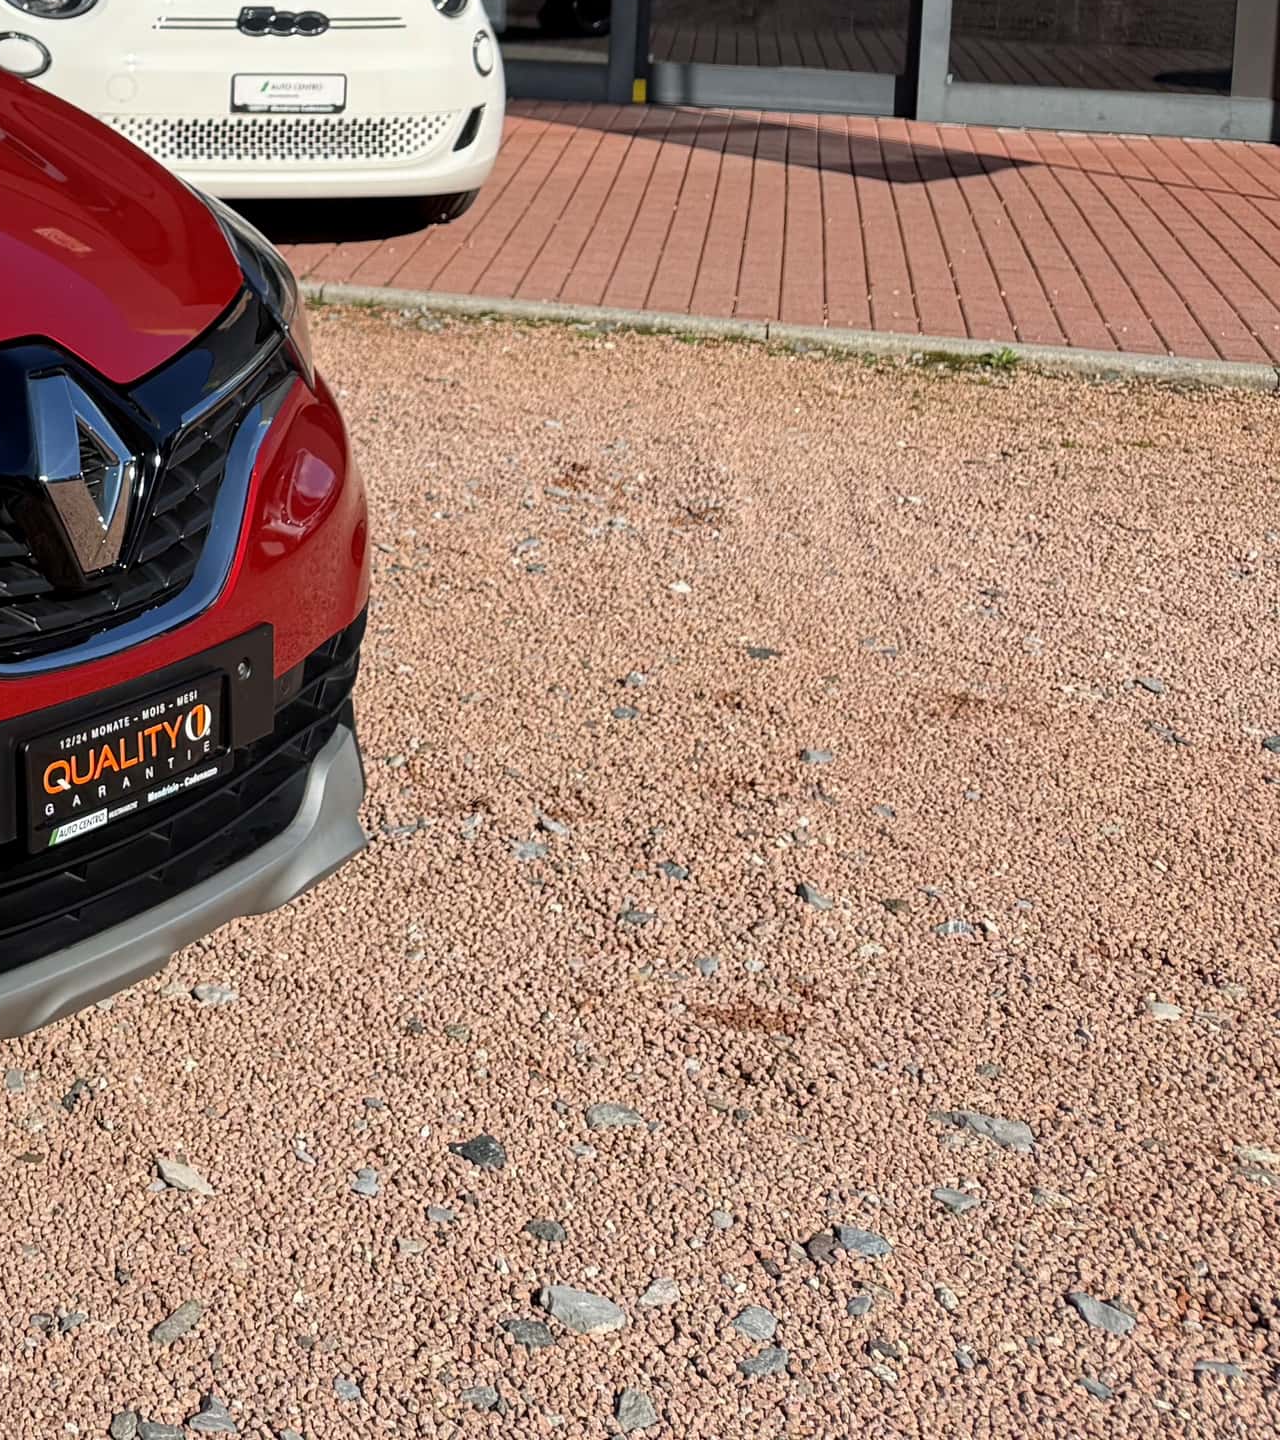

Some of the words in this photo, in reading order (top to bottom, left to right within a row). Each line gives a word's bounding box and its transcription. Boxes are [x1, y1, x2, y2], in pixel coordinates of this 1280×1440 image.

[59, 732, 88, 750] 12/24
[91, 715, 131, 738] MONATE
[141, 702, 166, 720] MOIS
[176, 689, 199, 707] MESI
[42, 714, 184, 795] QUALITY
[44, 740, 212, 816] GARANTIE
[57, 822, 78, 839] AUTO
[79, 812, 106, 831] CENTRO
